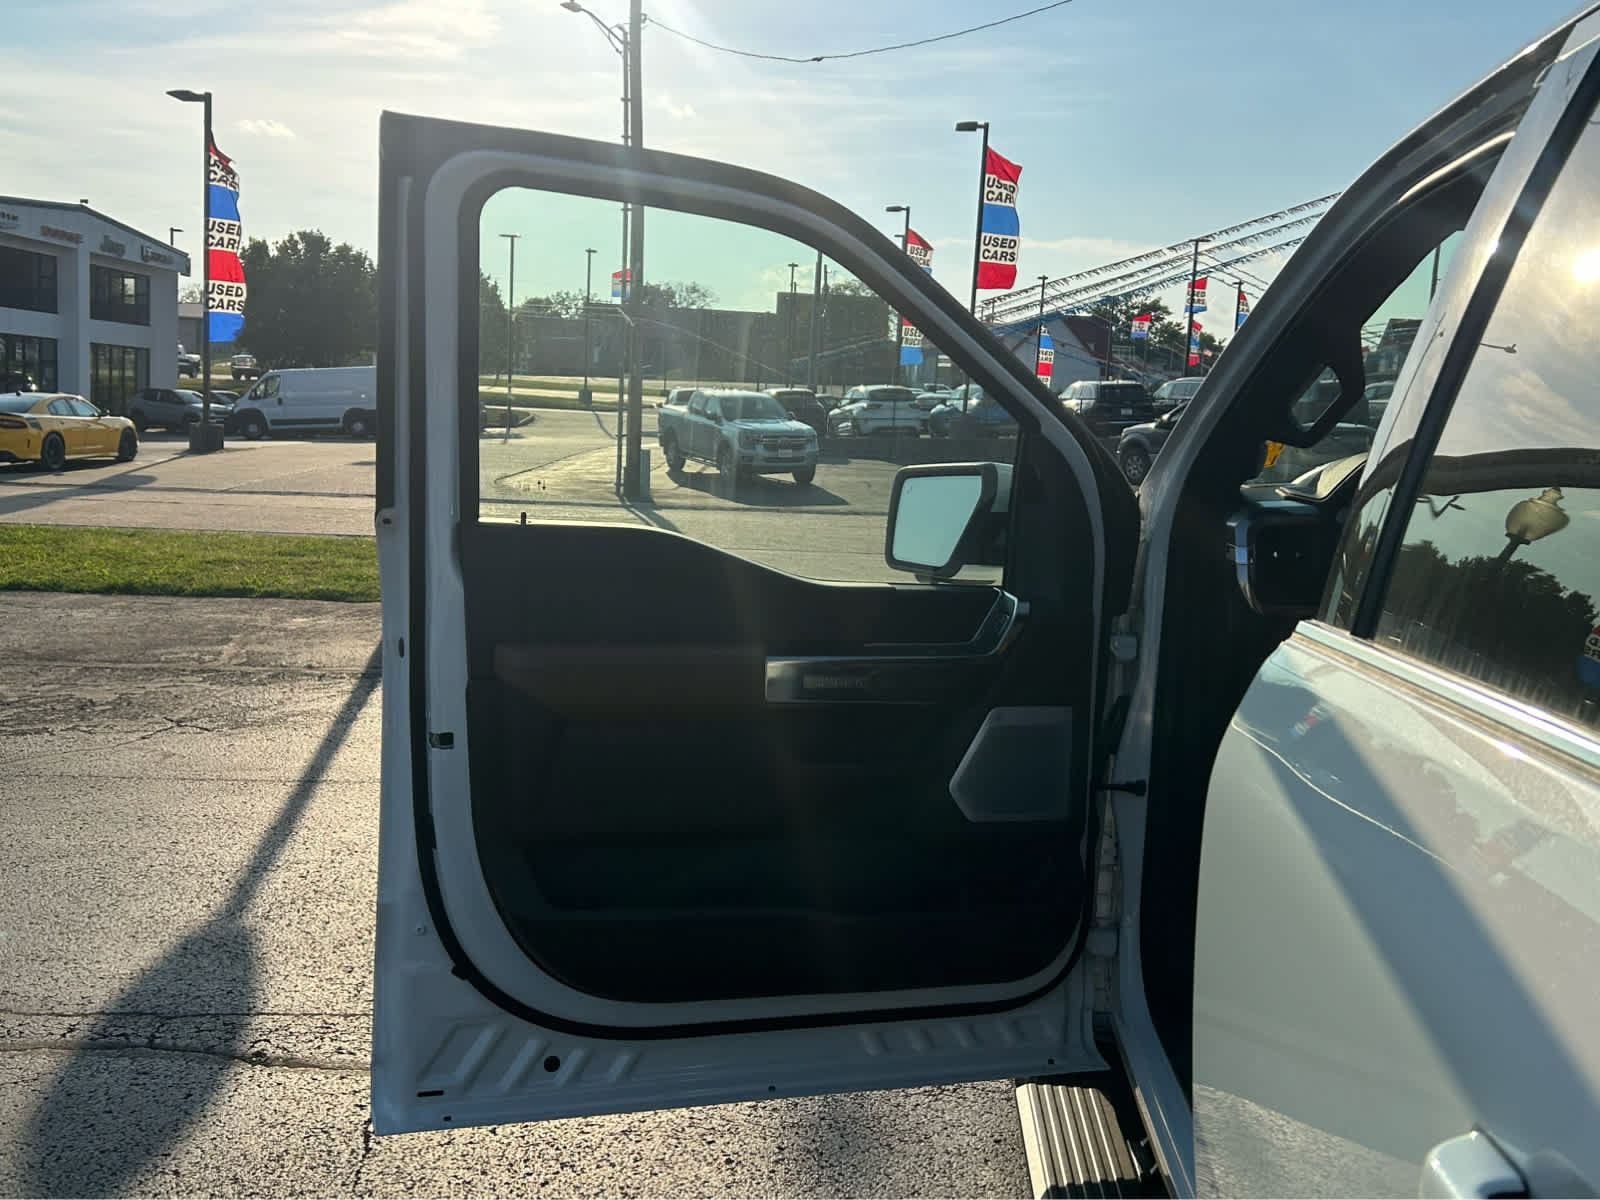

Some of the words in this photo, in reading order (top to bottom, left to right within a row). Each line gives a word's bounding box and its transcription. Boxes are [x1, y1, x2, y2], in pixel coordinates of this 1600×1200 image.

[982, 235, 1017, 249] USED
[982, 248, 1016, 262] CARS
[207, 282, 244, 297] USED
[207, 297, 245, 312] CARS
